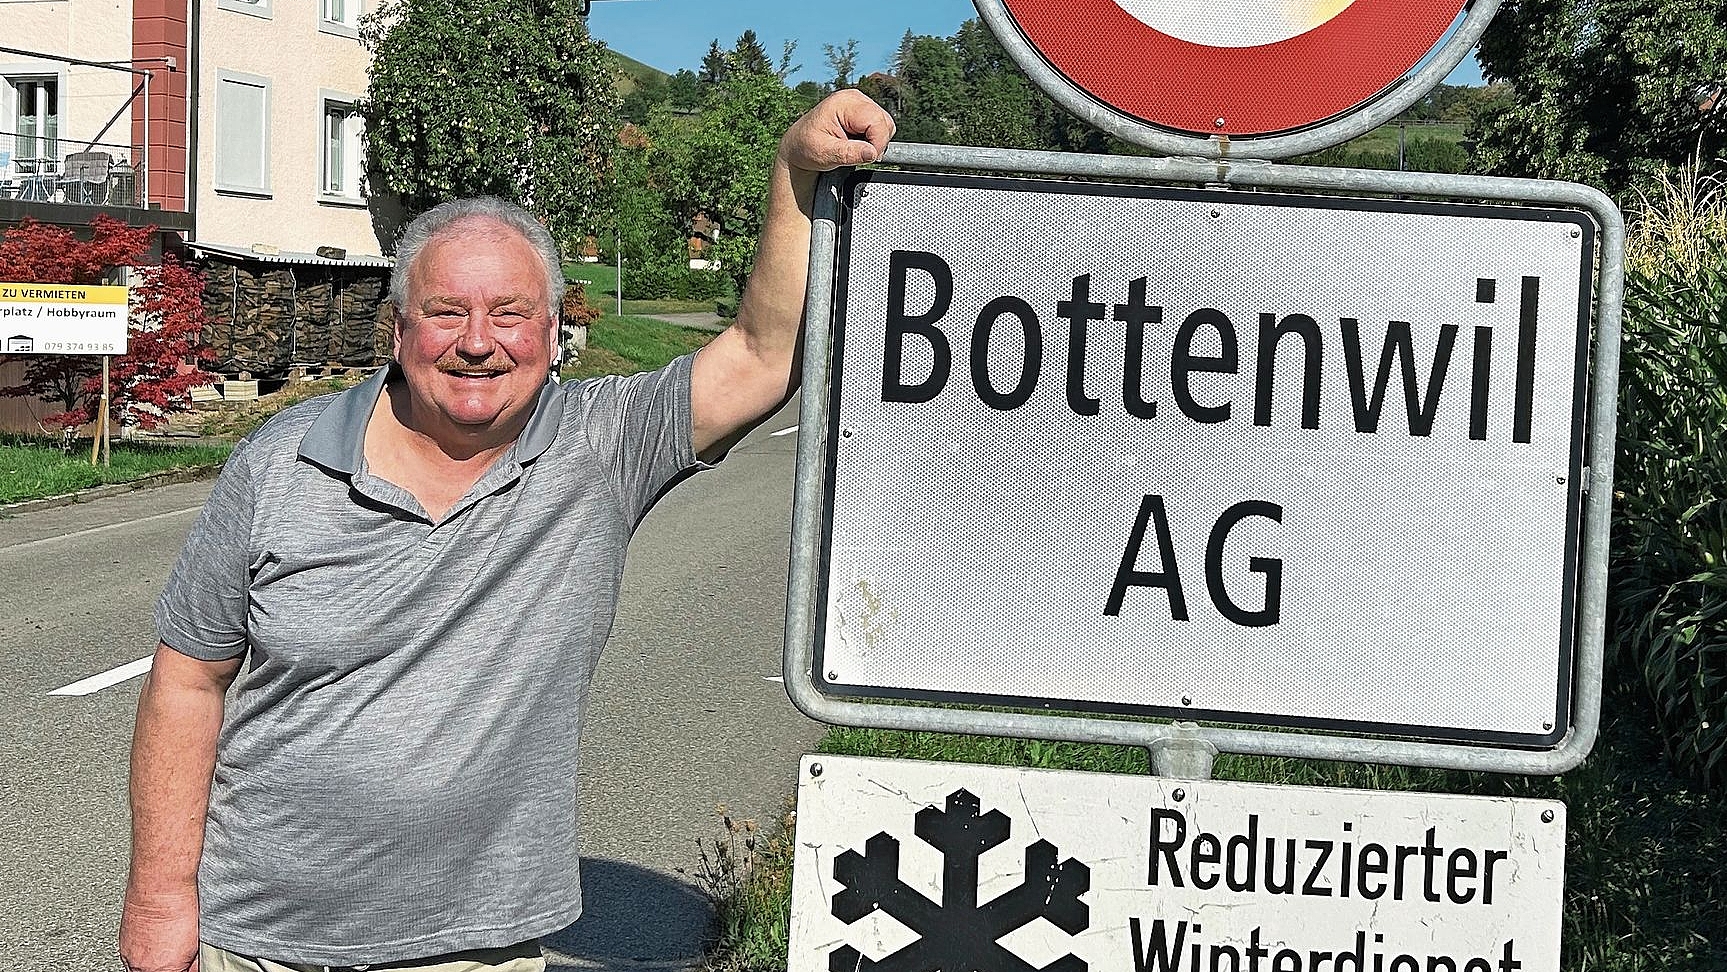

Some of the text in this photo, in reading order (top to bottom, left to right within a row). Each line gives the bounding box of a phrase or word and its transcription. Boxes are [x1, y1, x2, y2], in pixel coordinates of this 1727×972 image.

[0, 306, 33, 318] platz
[47, 307, 116, 320] Hobbyraum
[2, 288, 86, 300] ZU VERMIETEN
[44, 342, 114, 351] 079 374 93 85
[880, 248, 1541, 445] Bottenwil
[1102, 492, 1284, 630] AG
[1147, 807, 1508, 905] Reduzierter
[1128, 916, 1522, 972] Wintdi
